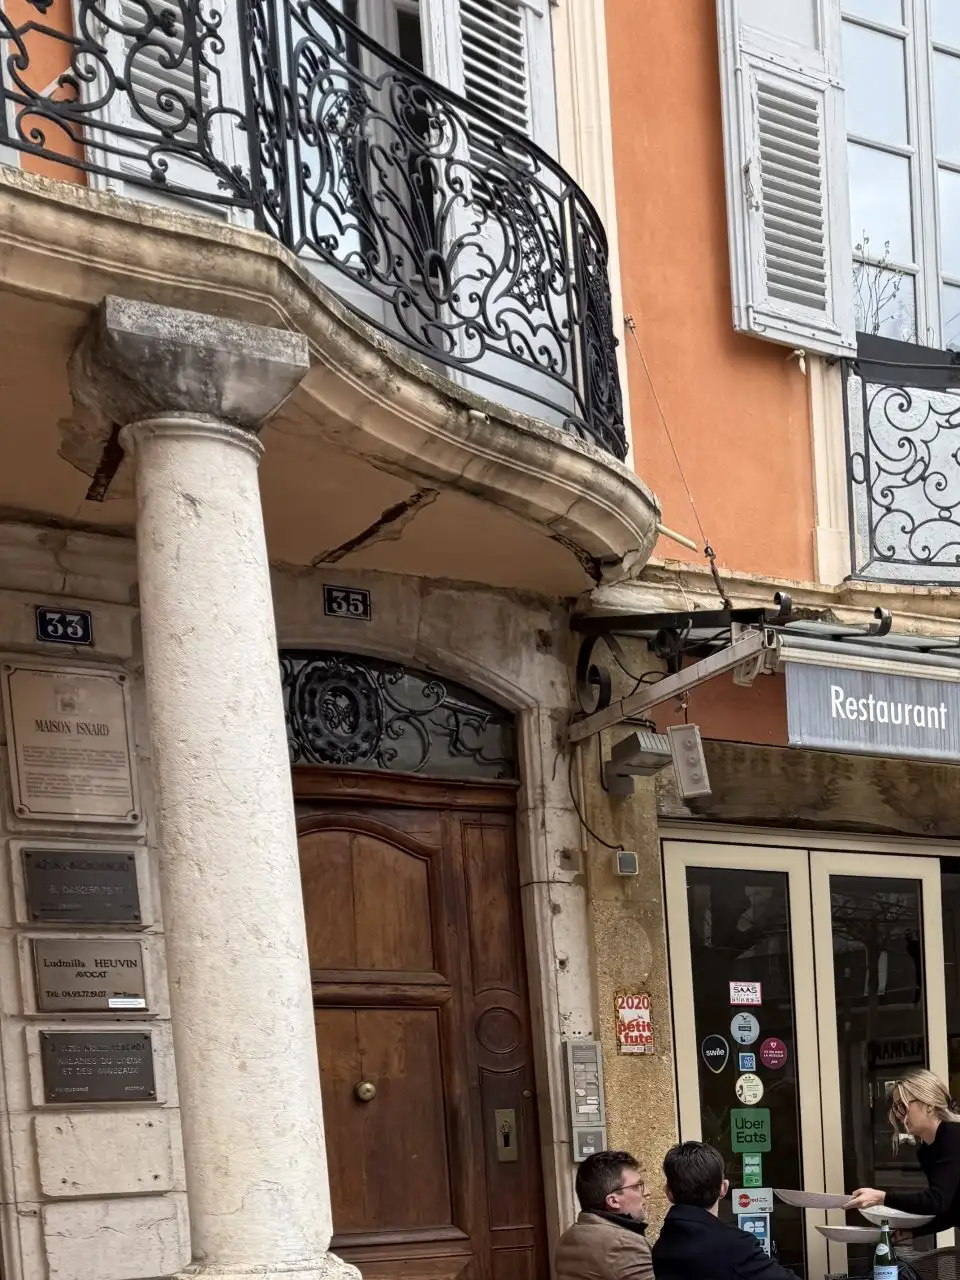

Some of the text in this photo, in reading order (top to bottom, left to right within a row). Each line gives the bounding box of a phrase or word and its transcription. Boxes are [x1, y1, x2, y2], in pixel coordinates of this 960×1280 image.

[332, 591, 364, 614] 35
[46, 613, 84, 638] 33
[830, 685, 948, 730] Restaurant
[35, 719, 110, 736] MAISON ISNARD
[43, 958, 138, 968] Ludmilla HEUVIN
[733, 986, 758, 994] SAAS
[618, 995, 649, 1010] 2020
[617, 1020, 652, 1036] petit
[705, 1047, 725, 1057] swile
[735, 1117, 765, 1130] Uber
[736, 1131, 767, 1144] Eats
